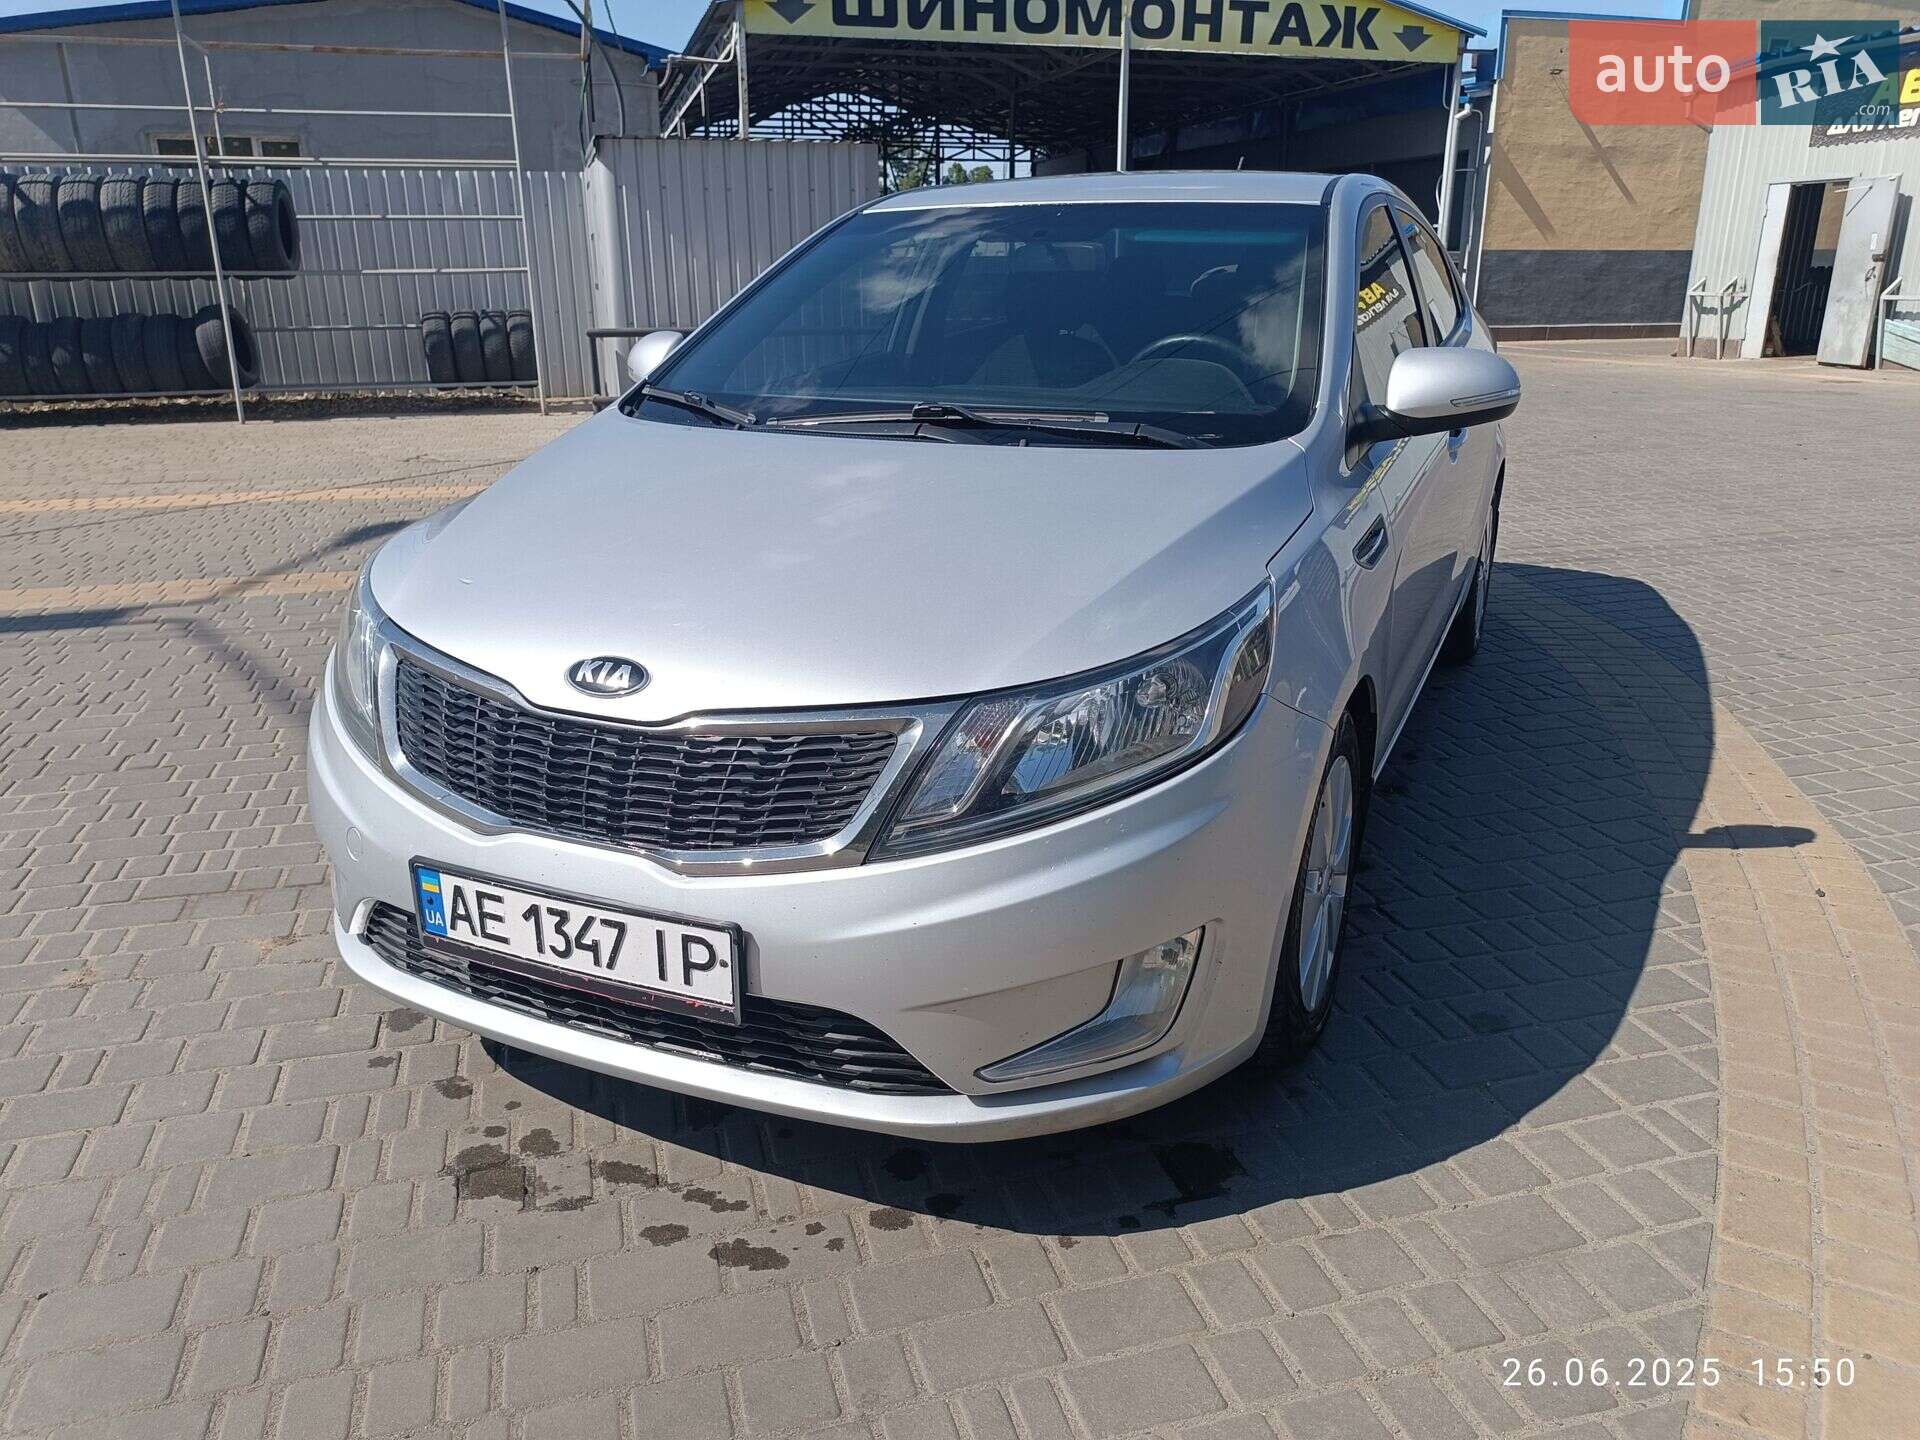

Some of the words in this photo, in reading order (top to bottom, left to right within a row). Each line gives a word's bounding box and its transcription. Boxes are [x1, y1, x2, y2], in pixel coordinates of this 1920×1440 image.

[831, 0, 1380, 50] ШИНОМОНТАЖ
[575, 659, 632, 688] KIA
[425, 909, 445, 927] UA
[450, 884, 510, 945] AE
[521, 903, 627, 970] 1347
[656, 929, 718, 987] IP
